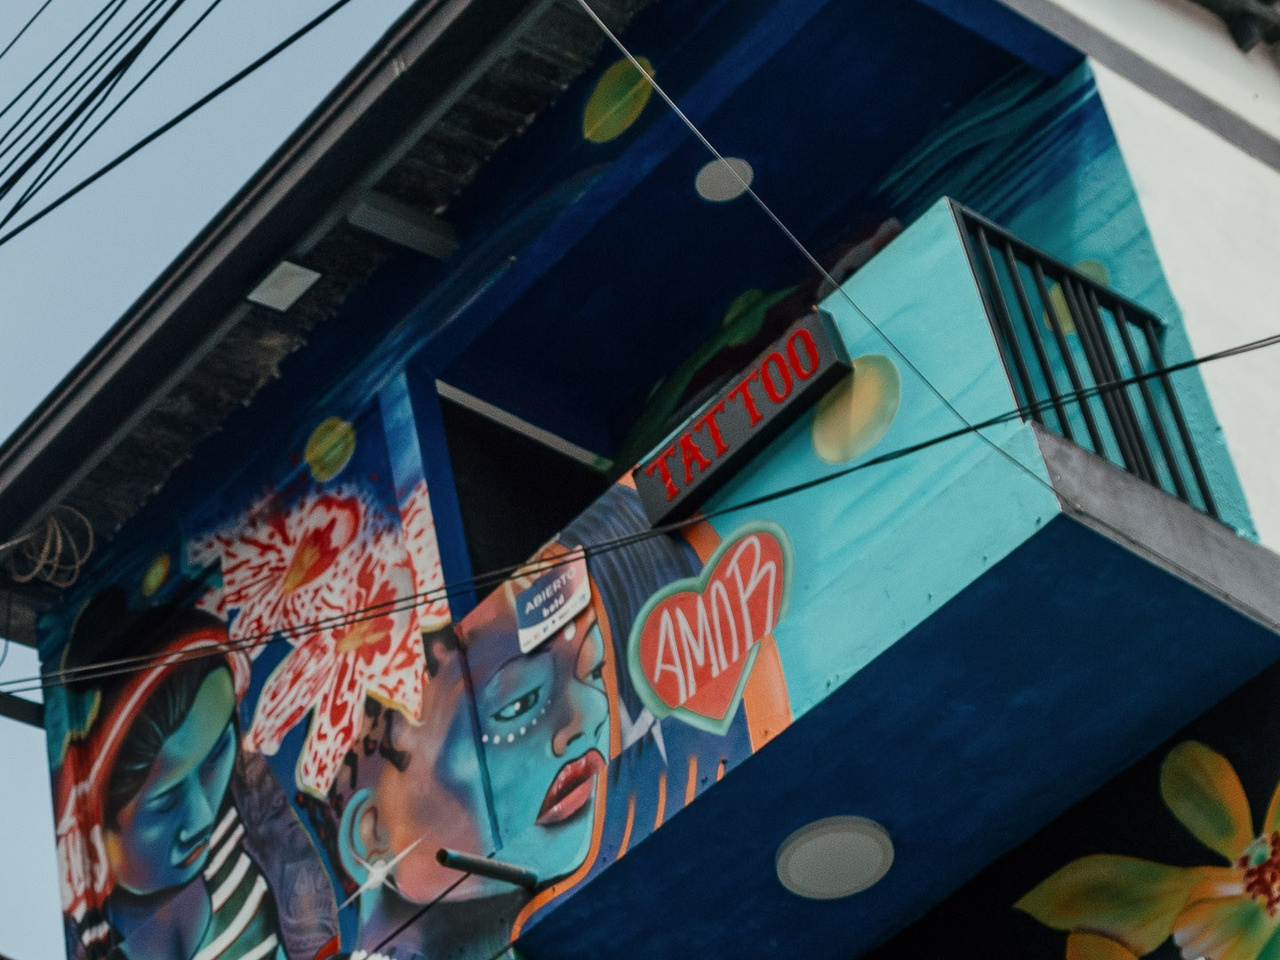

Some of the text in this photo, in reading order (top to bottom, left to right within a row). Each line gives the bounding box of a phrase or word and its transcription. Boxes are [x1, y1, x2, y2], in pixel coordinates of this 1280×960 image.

[645, 328, 820, 501] TATTOO
[524, 566, 576, 615] ABIERTO
[652, 535, 777, 705] AMOR
